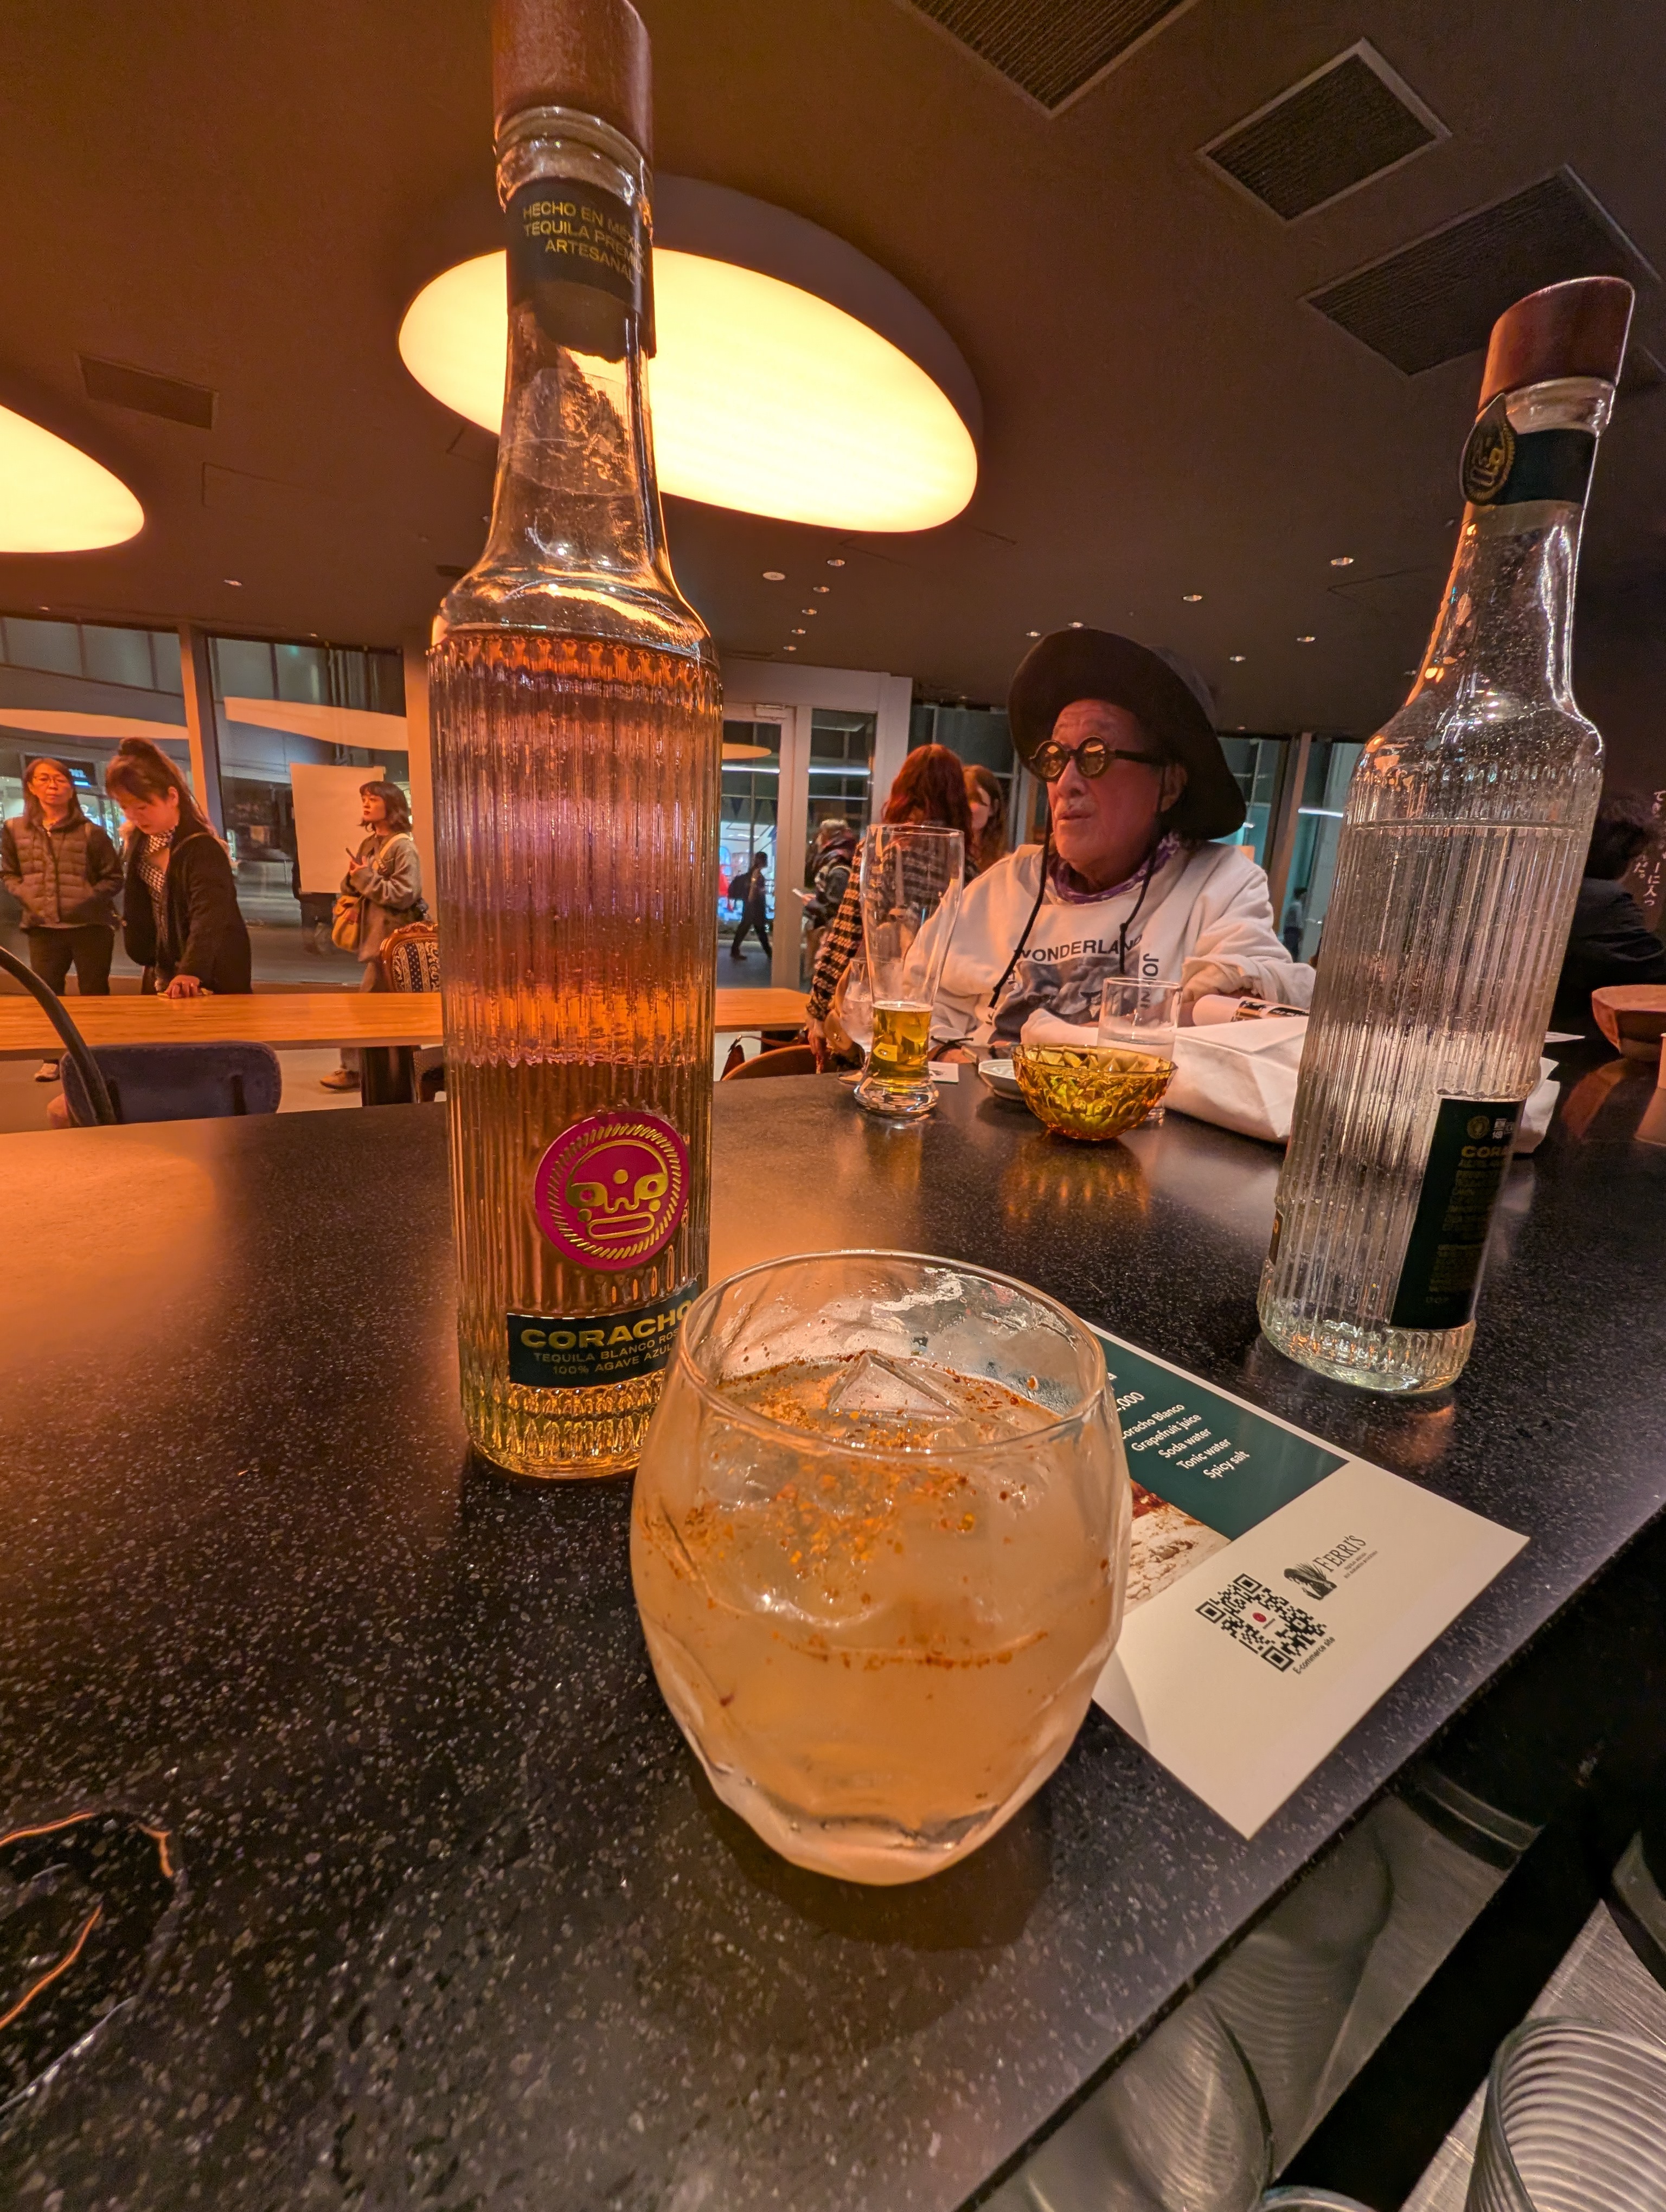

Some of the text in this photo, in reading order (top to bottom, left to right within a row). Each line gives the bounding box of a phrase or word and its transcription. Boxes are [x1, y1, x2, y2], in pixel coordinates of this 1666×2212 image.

[523, 201, 576, 218] HECHO
[580, 206, 604, 227] EN
[524, 221, 589, 239] TEQUILA
[521, 1300, 691, 1349] CORACHO
[534, 1329, 679, 1362] TEQUILA BLANCO ROS
[553, 1343, 672, 1375] 100% AGAVE AZUL
[1151, 1403, 1185, 1422] Blanco
[1131, 1413, 1202, 1452] Grapefruit juice
[1158, 1427, 1212, 1459] Soda water
[1176, 1438, 1232, 1470] Tonic water
[1203, 1450, 1250, 1479] Spicy salt
[1292, 1636, 1335, 1675] E-commerce site
